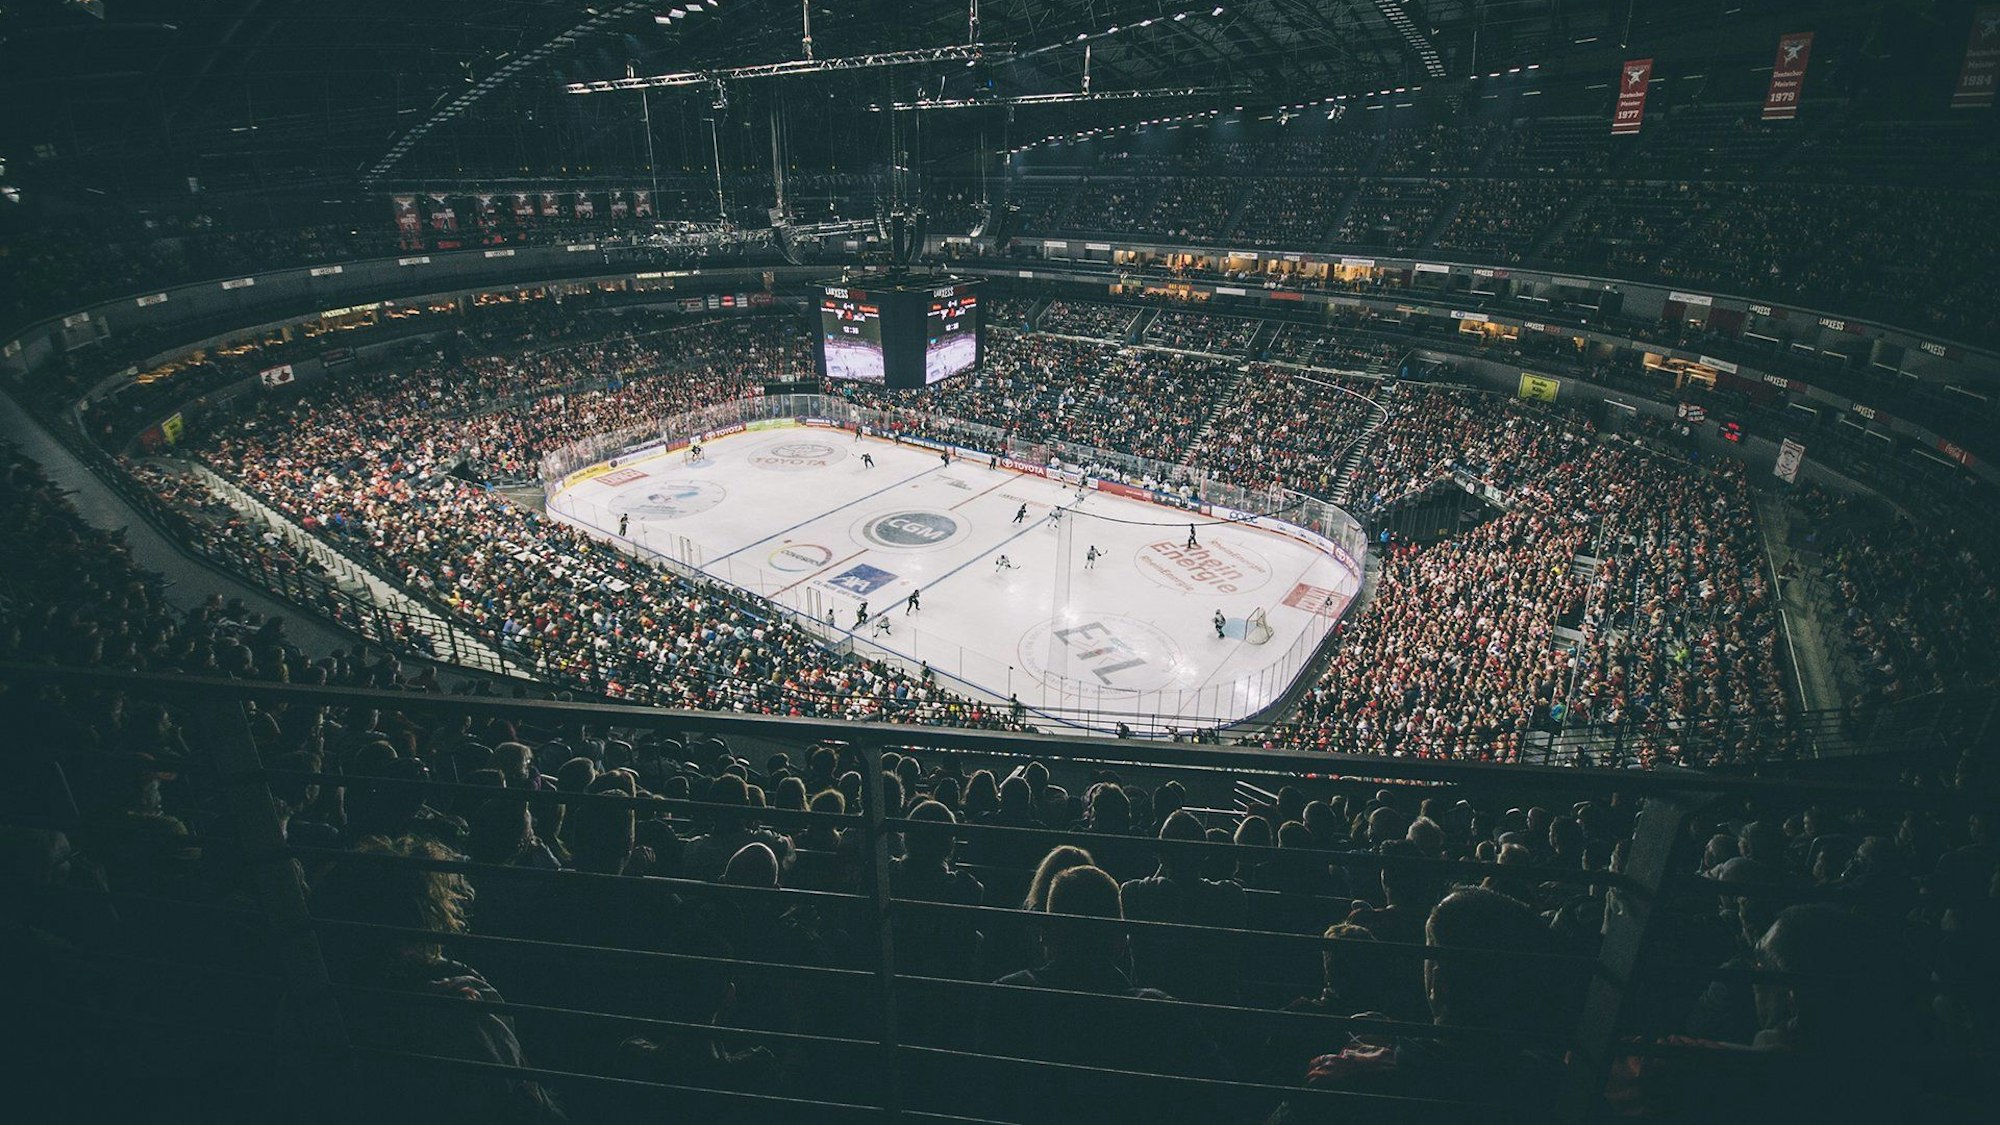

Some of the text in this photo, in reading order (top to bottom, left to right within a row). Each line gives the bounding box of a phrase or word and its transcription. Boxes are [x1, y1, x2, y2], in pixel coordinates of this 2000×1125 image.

[1770, 92, 1795, 102] 1979
[1618, 110, 1640, 120] 1977
[1818, 317, 1845, 331] LANXESS
[1921, 341, 1947, 357] LANXESS
[1852, 403, 1876, 419] LANXESS
[715, 425, 744, 438] TOYOTA
[754, 457, 827, 467] TOYOTA
[1014, 462, 1045, 475] TOYOTA
[888, 518, 946, 540] CGM
[1150, 541, 1238, 594] Energie
[1179, 541, 1244, 581] Rhein
